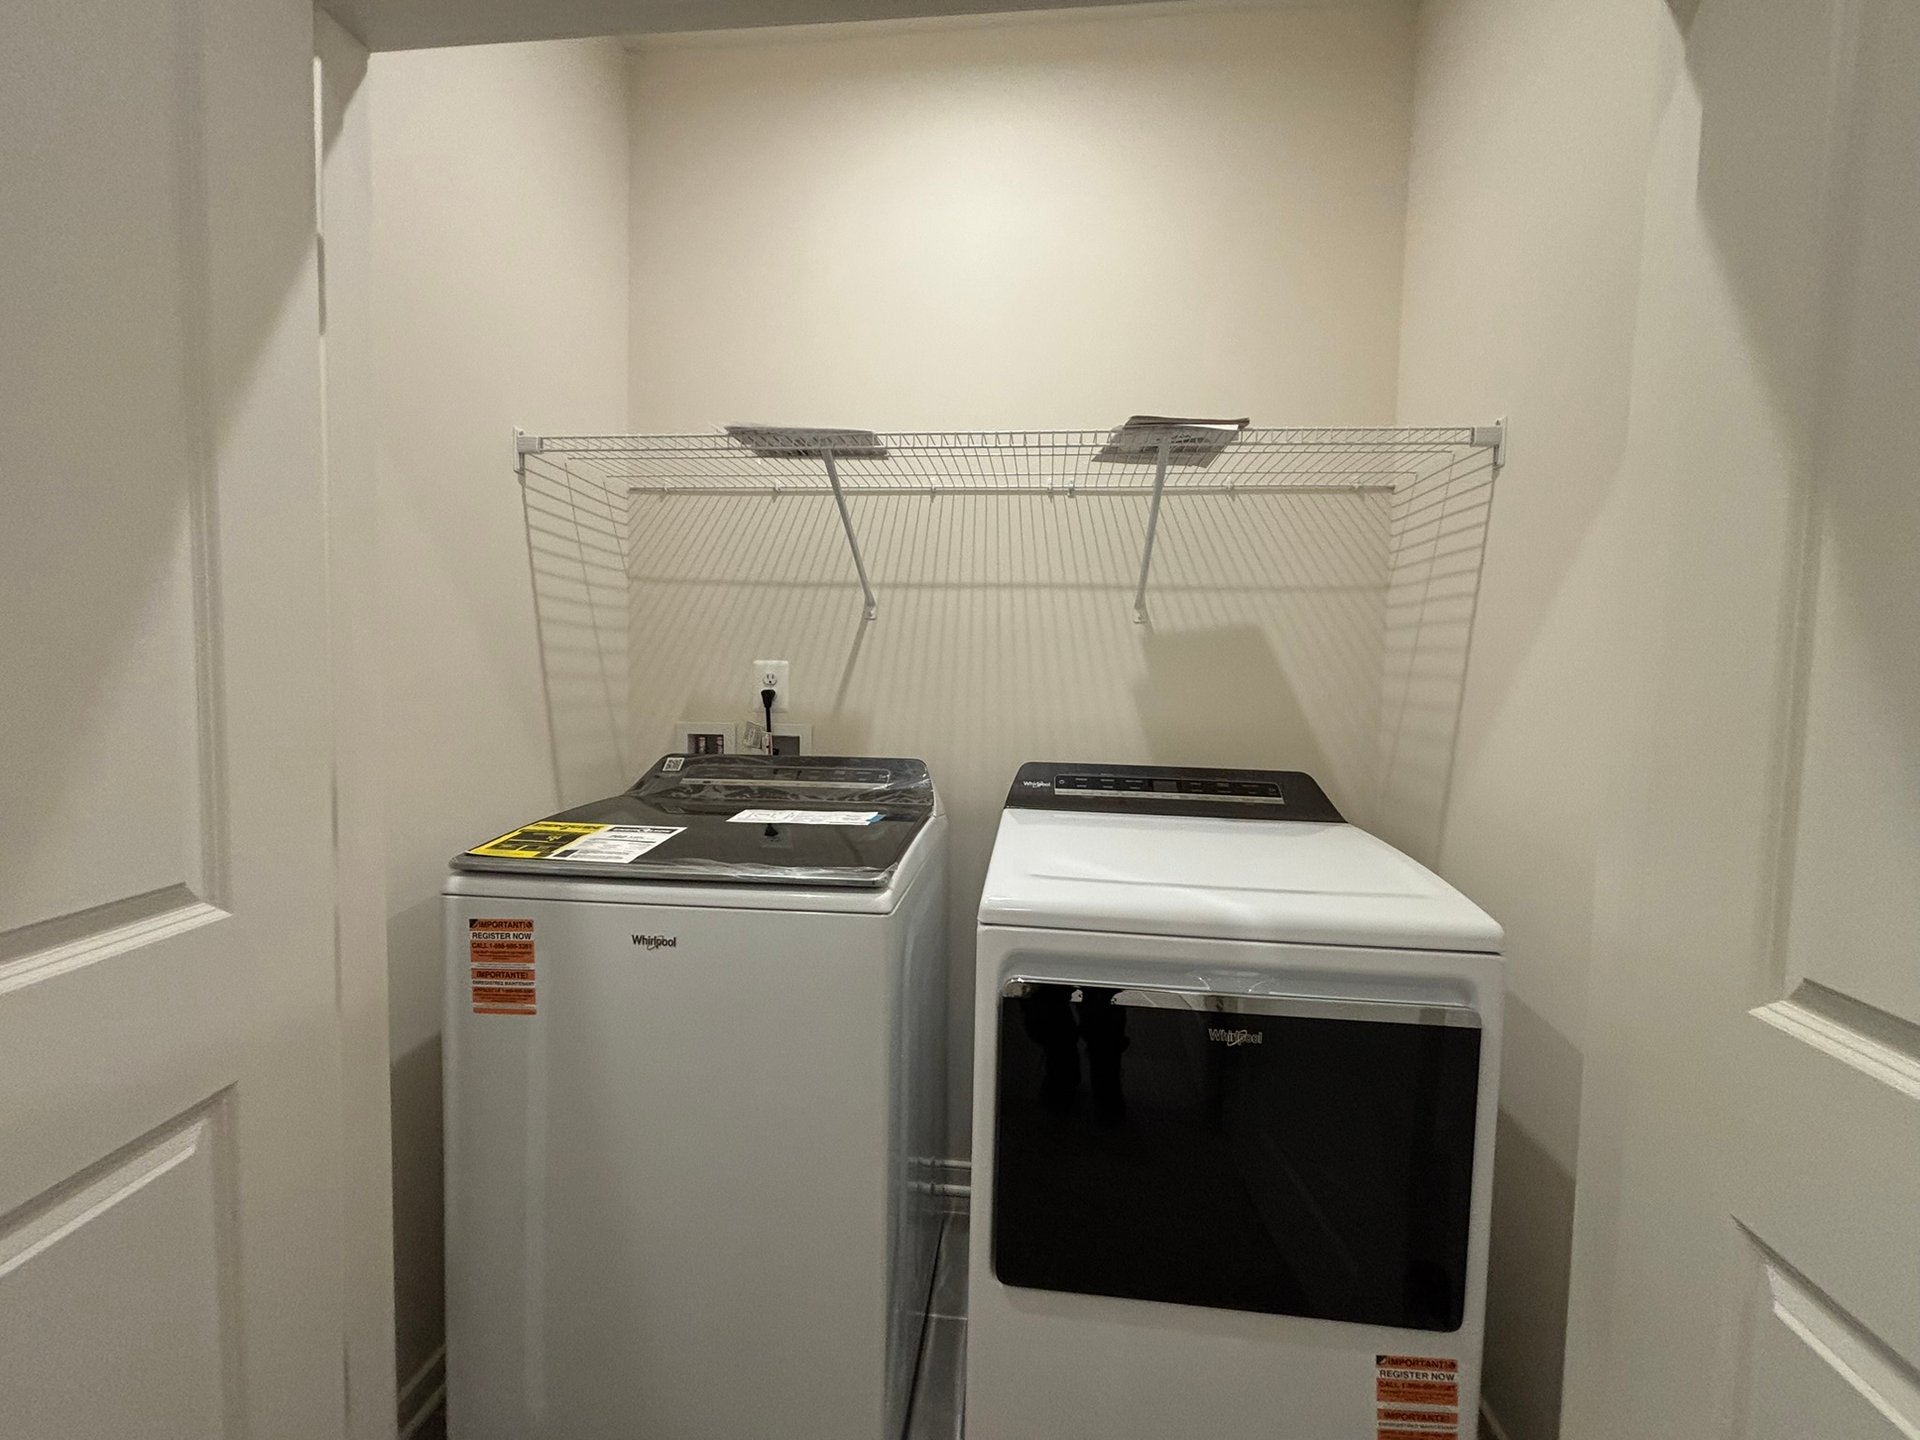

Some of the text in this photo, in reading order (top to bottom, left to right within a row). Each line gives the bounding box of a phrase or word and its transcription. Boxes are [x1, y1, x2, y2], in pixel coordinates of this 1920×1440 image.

[1023, 780, 1051, 788] Whirlpool
[472, 932, 532, 940] REGISTER NOW
[631, 934, 676, 950] Whirlpool
[1208, 1028, 1262, 1046] Whirlpool
[1379, 1369, 1455, 1381] REGISTER NOW
